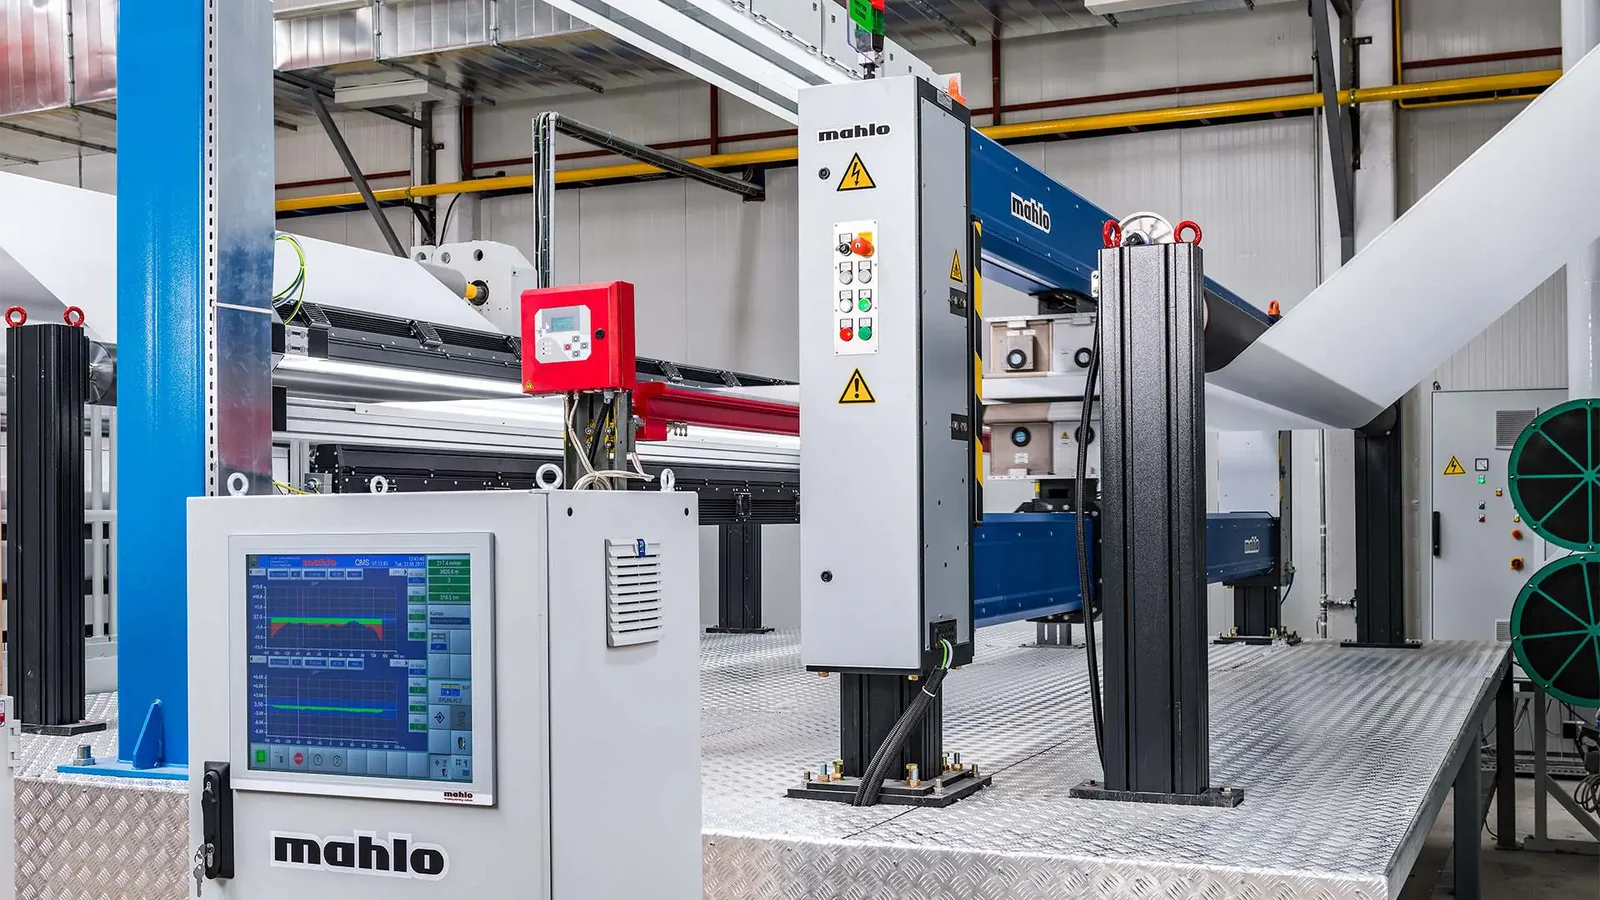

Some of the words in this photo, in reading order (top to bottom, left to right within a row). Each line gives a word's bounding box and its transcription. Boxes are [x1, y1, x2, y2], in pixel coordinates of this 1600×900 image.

[818, 123, 891, 142] mahlo
[1012, 195, 1050, 231] mahlo
[355, 558, 370, 567] QMS
[274, 835, 445, 876] mahlo
